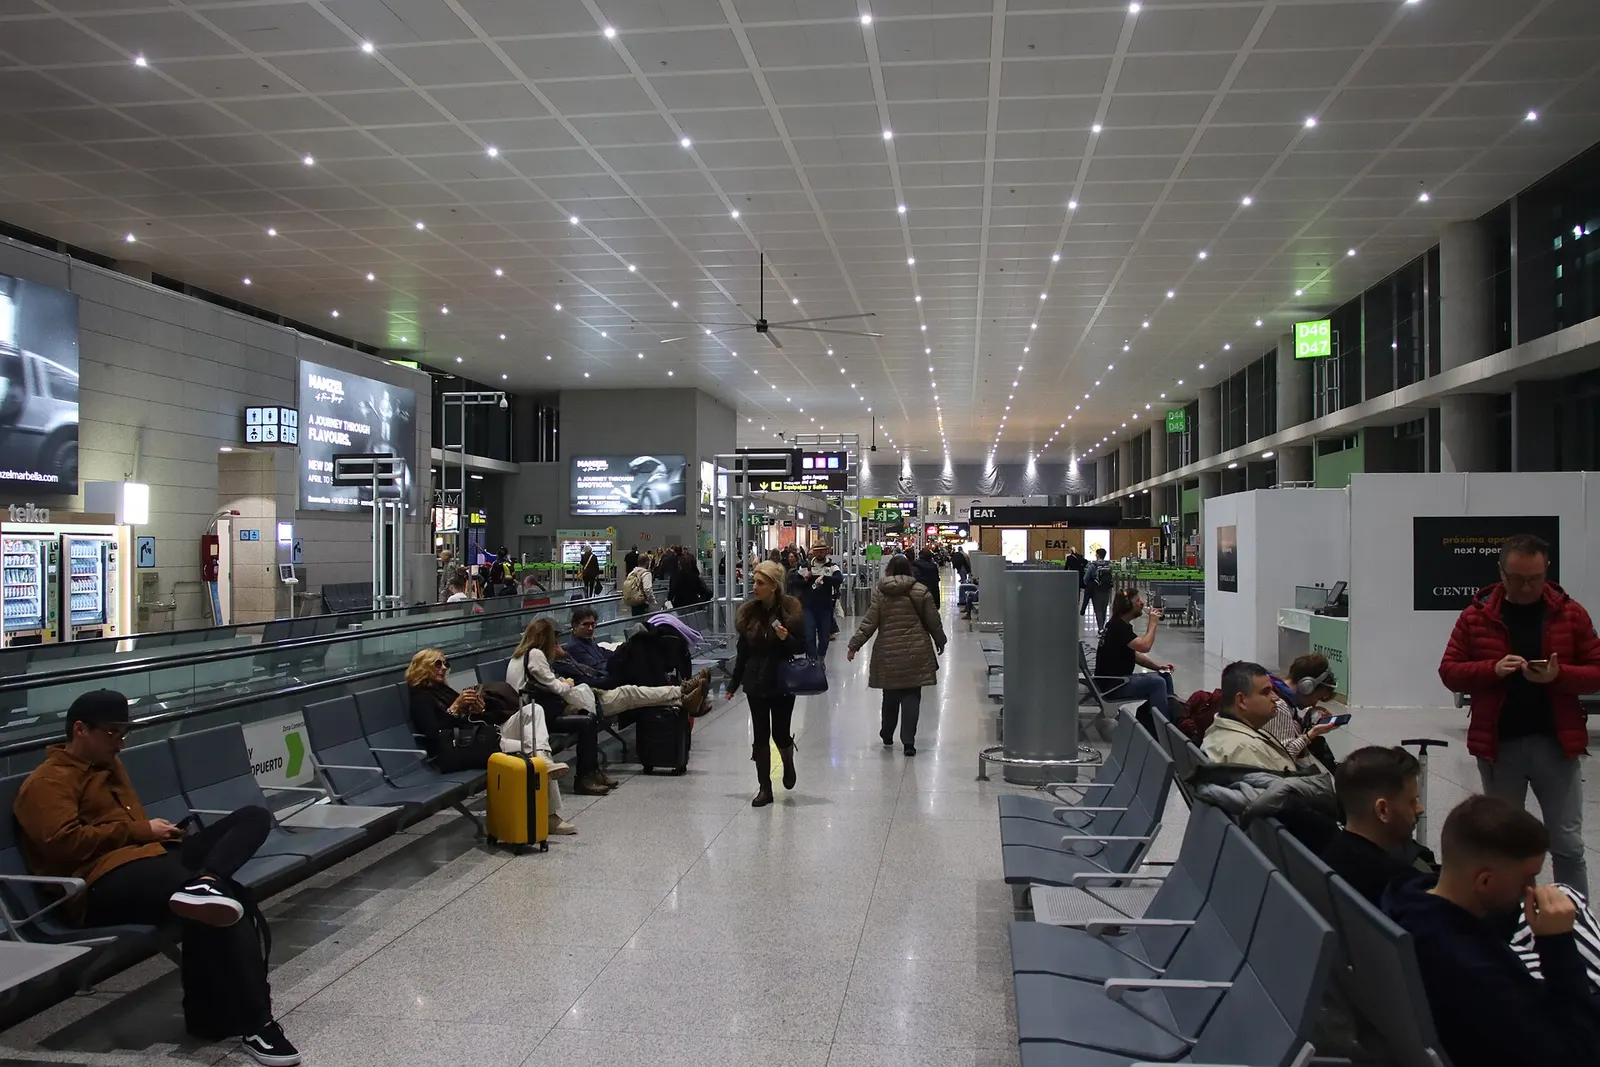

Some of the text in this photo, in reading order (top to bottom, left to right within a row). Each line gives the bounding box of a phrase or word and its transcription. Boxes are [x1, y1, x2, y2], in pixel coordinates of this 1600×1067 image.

[1298, 322, 1328, 338] D46
[1299, 341, 1328, 355] D47
[1168, 411, 1184, 420] D44
[308, 414, 370, 435] A JOURNEY THROUGH
[1168, 422, 1184, 431] D45
[308, 460, 324, 470] NEW
[0, 469, 58, 482] zelmarbella.com
[308, 474, 322, 483] APRIL
[323, 476, 330, 484] TO
[9, 503, 50, 522] teika
[973, 509, 996, 518] EAT.
[1045, 539, 1069, 549] EAT.
[1442, 535, 1510, 546] próxima aper
[1478, 548, 1502, 556] oper
[1432, 586, 1480, 596] CENTR
[1324, 646, 1342, 663] COFFEE
[248, 748, 254, 759] Y
[251, 757, 282, 776] OPUERTO
